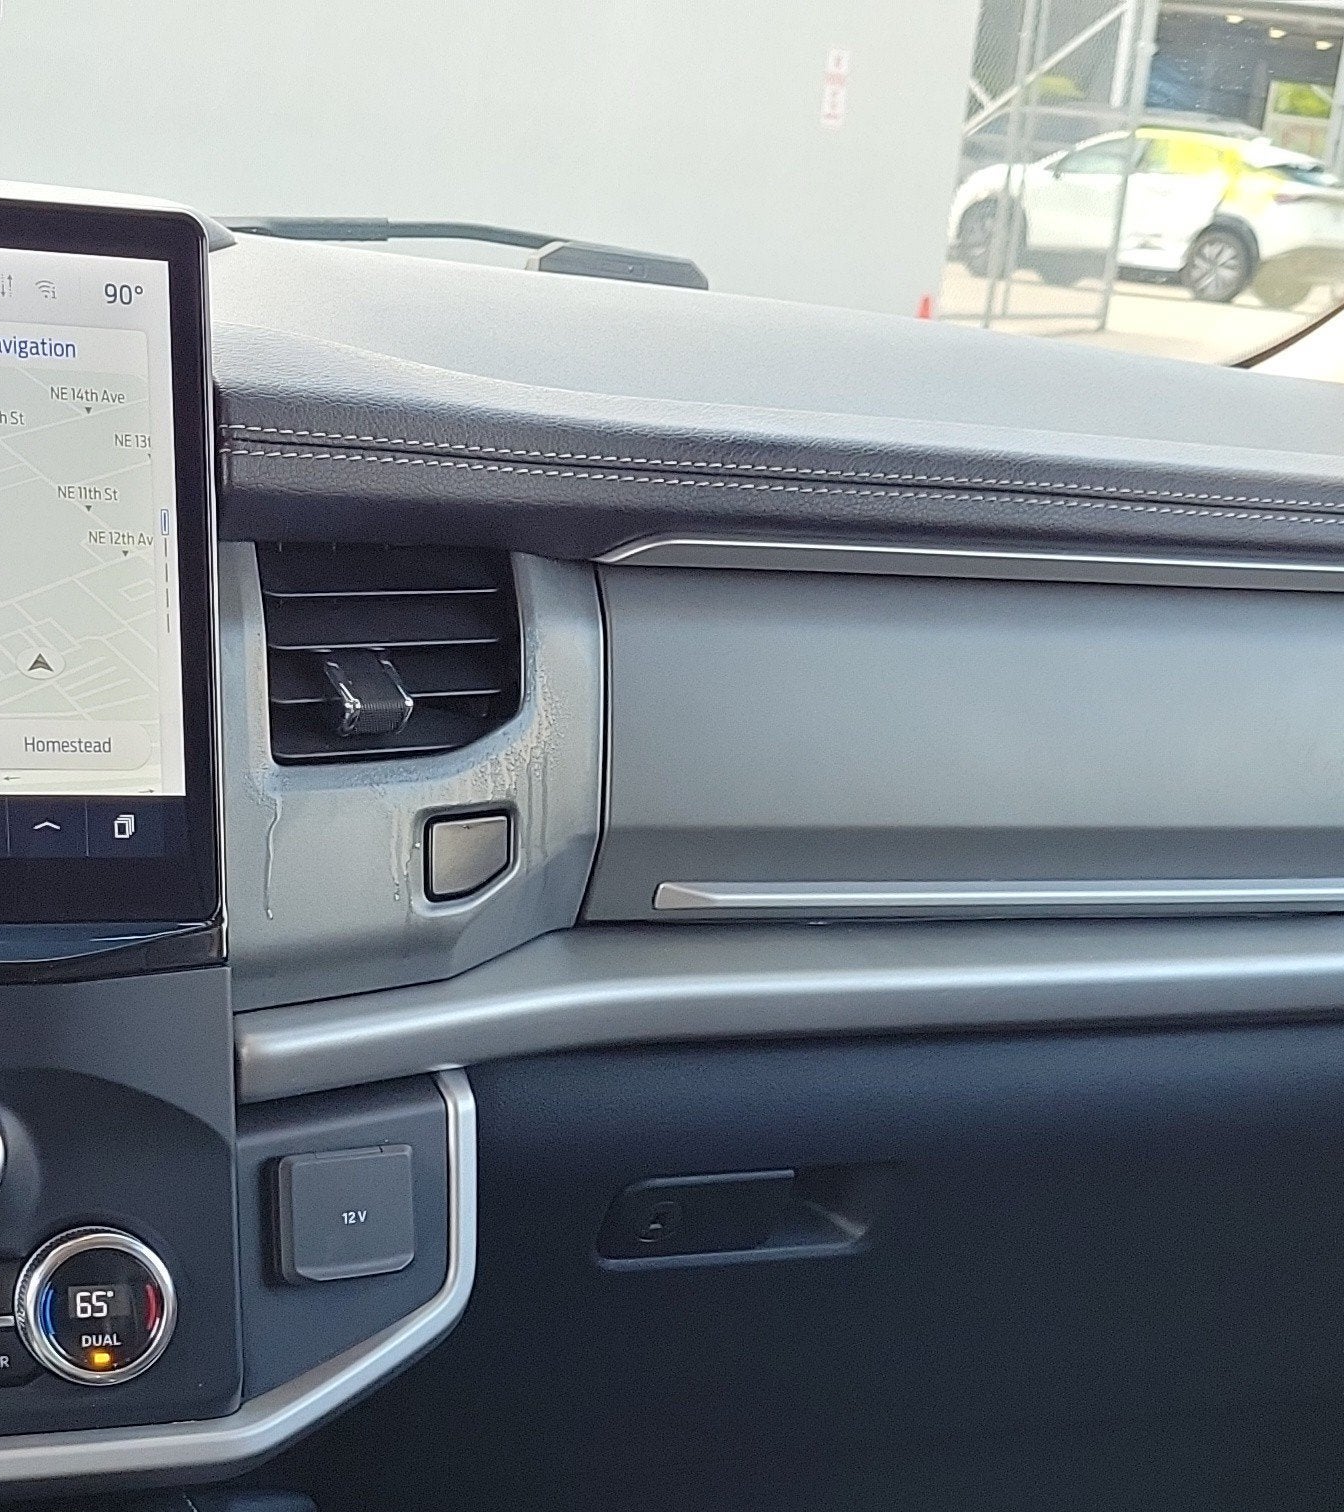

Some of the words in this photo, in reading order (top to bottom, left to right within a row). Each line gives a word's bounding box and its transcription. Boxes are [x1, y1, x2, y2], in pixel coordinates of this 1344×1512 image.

[50, 386, 69, 402] NE
[71, 387, 97, 403] 14th
[99, 389, 125, 405] Ave
[9, 410, 25, 426] St
[114, 433, 132, 448] NE
[57, 485, 75, 500] NE
[77, 486, 102, 500] 11th
[104, 487, 118, 501] St
[88, 530, 105, 544] NE
[108, 531, 135, 545] 12th
[23, 735, 112, 754] Homestead
[81, 1333, 122, 1347] DUAL
